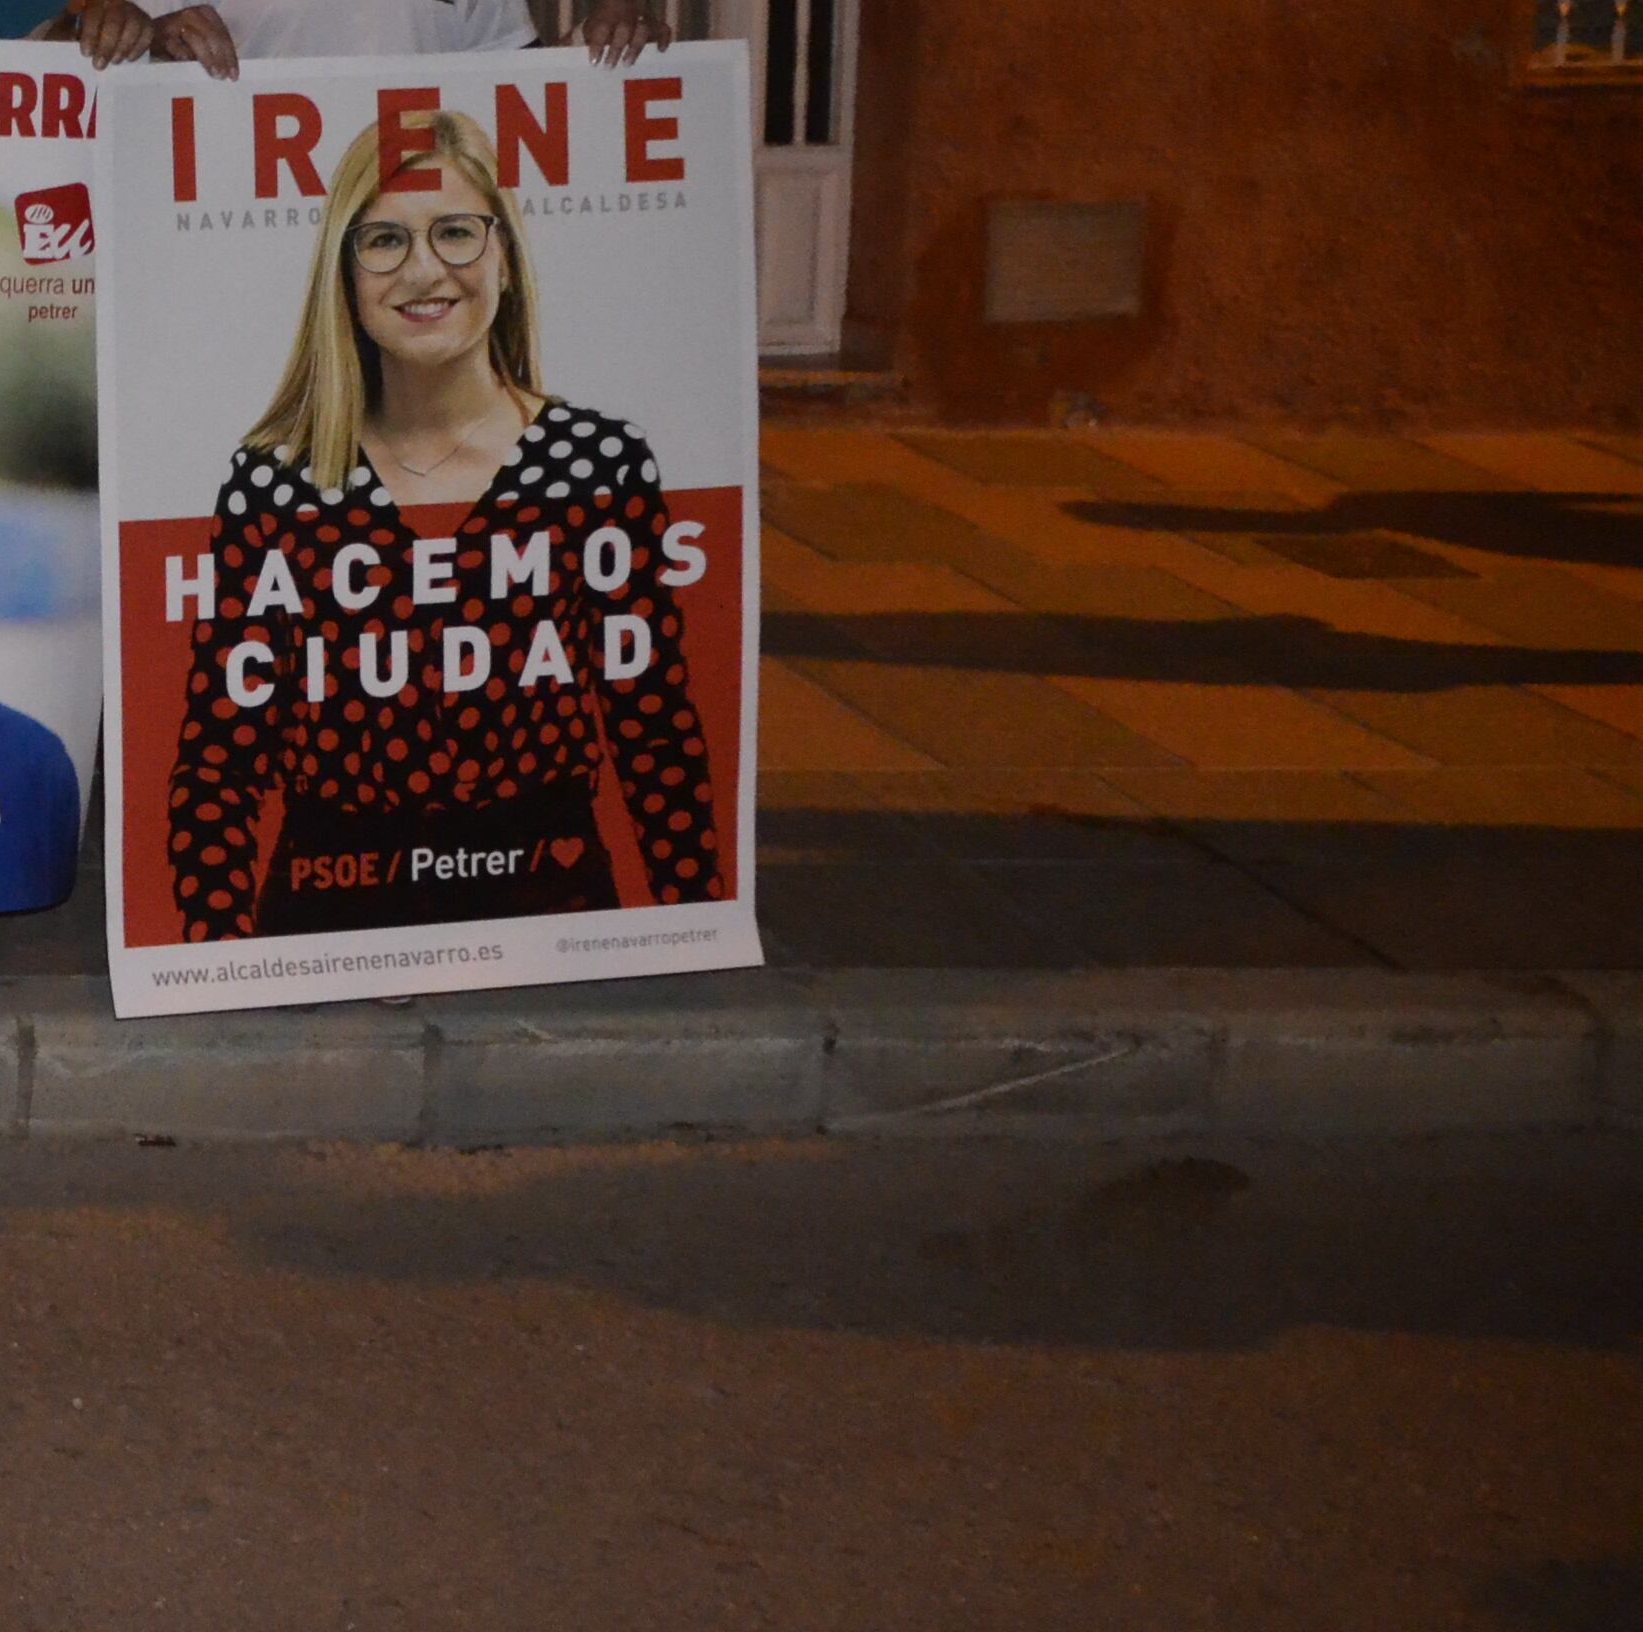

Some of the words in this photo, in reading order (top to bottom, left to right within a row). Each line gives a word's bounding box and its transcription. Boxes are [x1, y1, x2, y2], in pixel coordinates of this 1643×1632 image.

[171, 76, 685, 203] IRENE
[176, 206, 323, 232] NAVARRO
[522, 191, 688, 217] ALCALDESA
[28, 304, 78, 323] petrer
[164, 520, 708, 623] HACEMOS
[224, 612, 654, 709] CIUDAD
[290, 850, 380, 893] PSOE
[409, 845, 526, 883] Petrer
[152, 942, 504, 988] www.alcaldesairenenavarro.es
